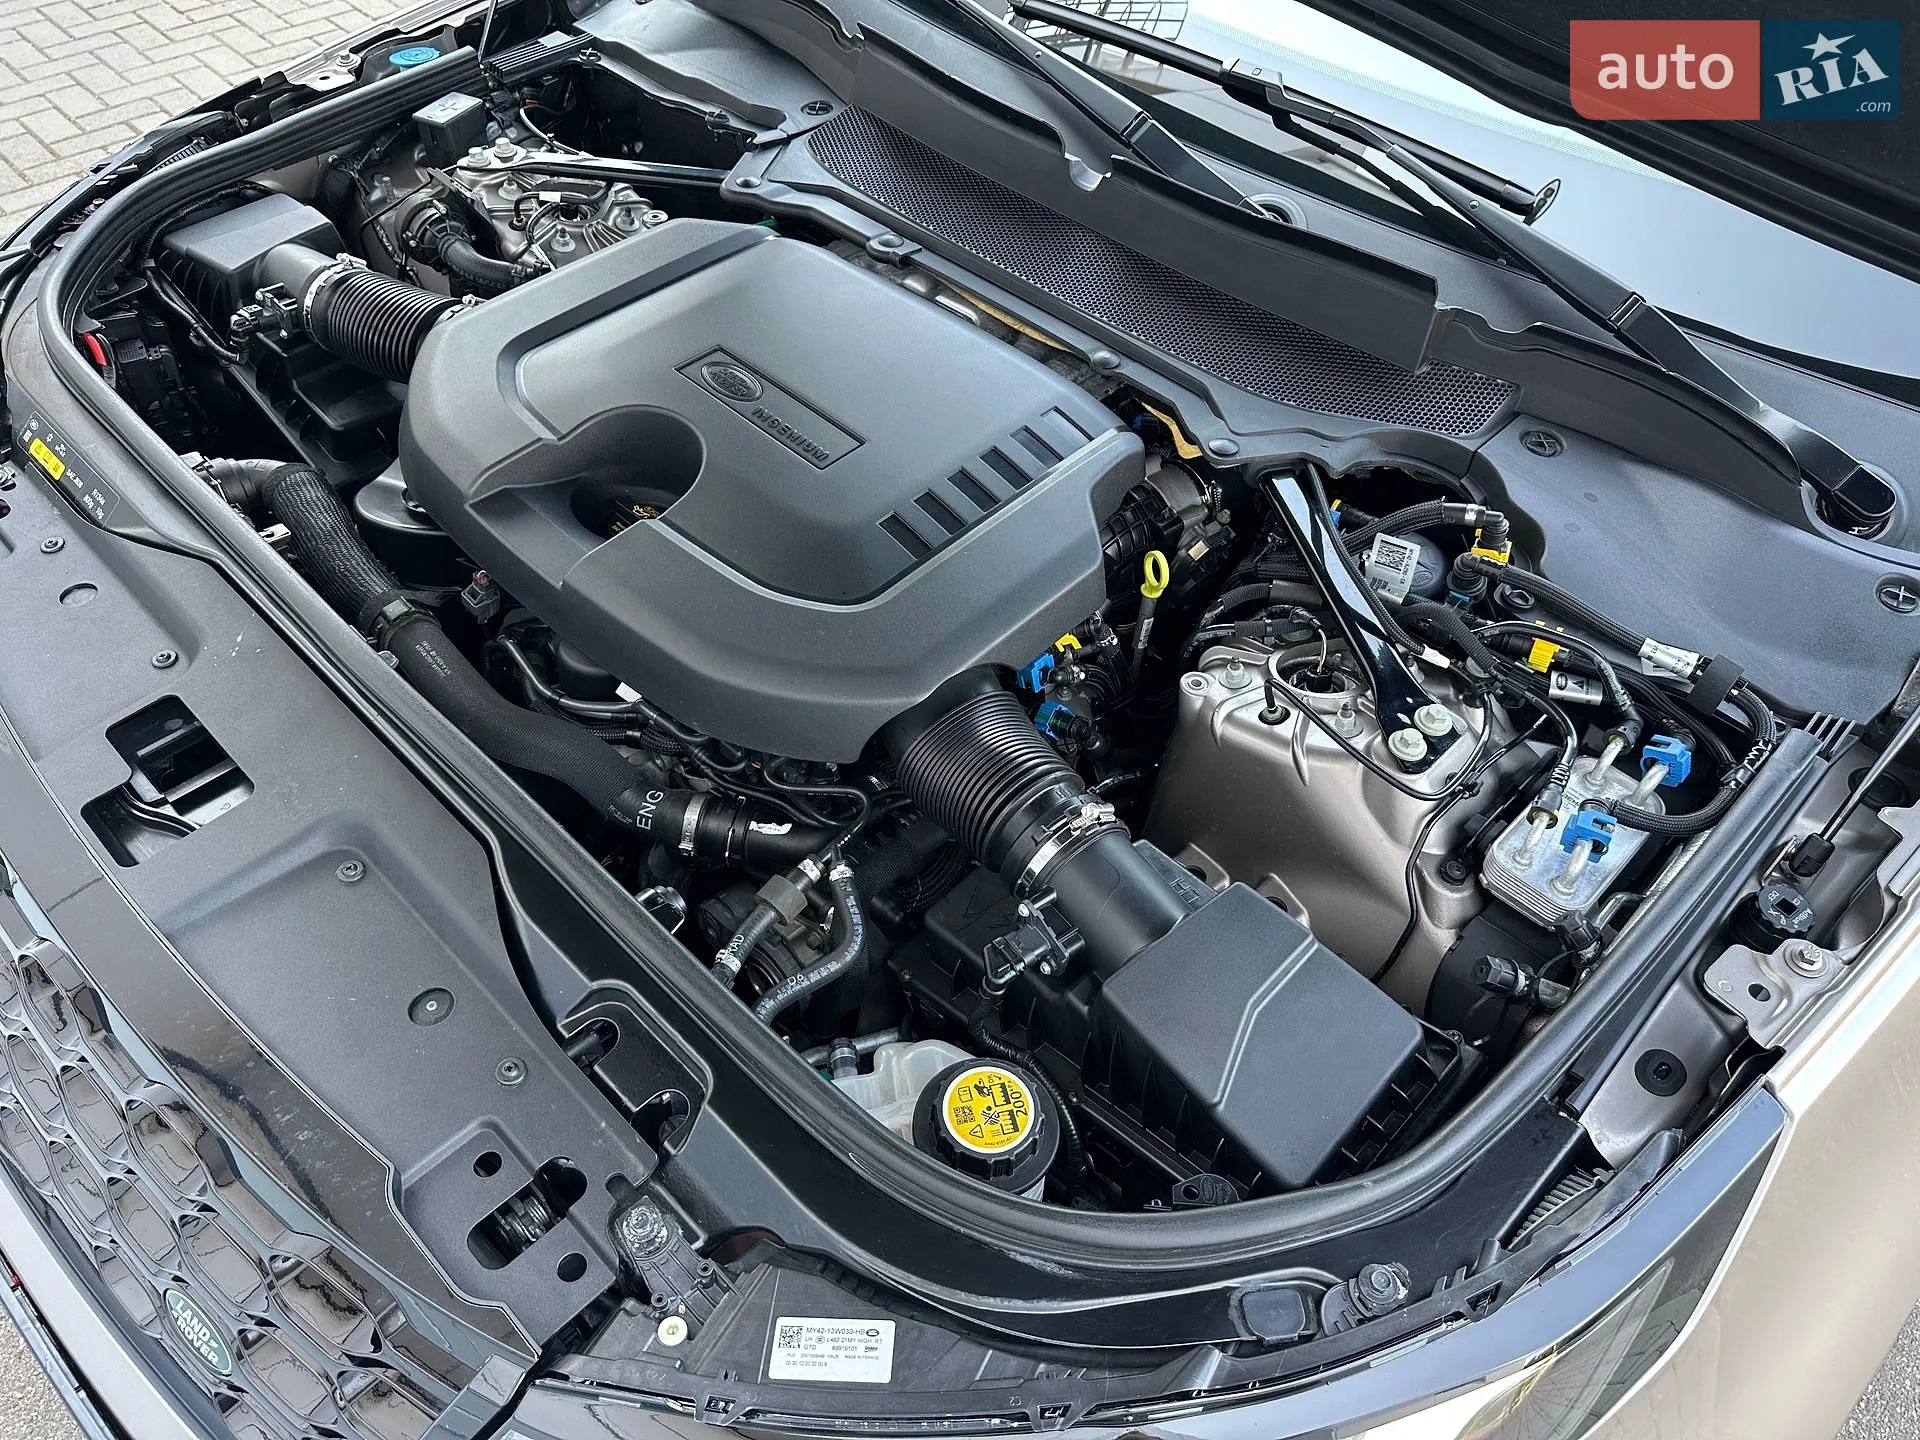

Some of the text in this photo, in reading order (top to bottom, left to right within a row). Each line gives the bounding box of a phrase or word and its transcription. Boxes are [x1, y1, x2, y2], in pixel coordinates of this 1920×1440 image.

[751, 405, 831, 461] INGENIUM
[92, 488, 106, 506] R134a
[636, 789, 664, 830] ENG
[1767, 890, 1779, 902] DEF
[1792, 907, 1813, 925] AdBlue
[728, 934, 744, 956] RAD
[1010, 1091, 1028, 1117] 200
[176, 1299, 211, 1341] LAND
[177, 1318, 219, 1366] ROVER
